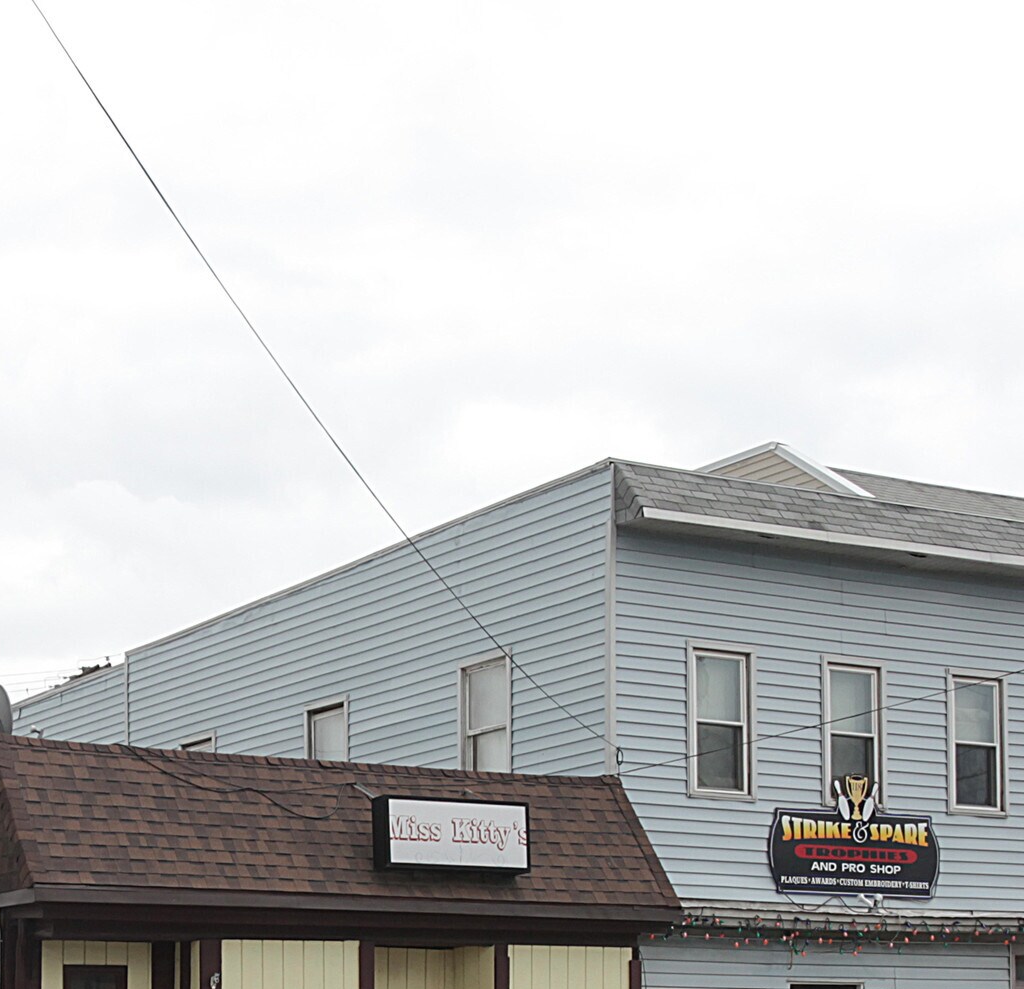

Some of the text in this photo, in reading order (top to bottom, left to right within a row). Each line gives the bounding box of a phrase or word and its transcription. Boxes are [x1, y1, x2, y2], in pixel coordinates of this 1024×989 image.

[390, 815, 527, 851] Miss Kitty's
[781, 815, 929, 847] STRIKE & SPARE
[804, 846, 909, 861] TROPHIES
[811, 862, 901, 875] AND PRO SHOP
[780, 875, 929, 890] PLAQUES AWARDS CUSTOM EMBROIDERY T-SHIRTS
